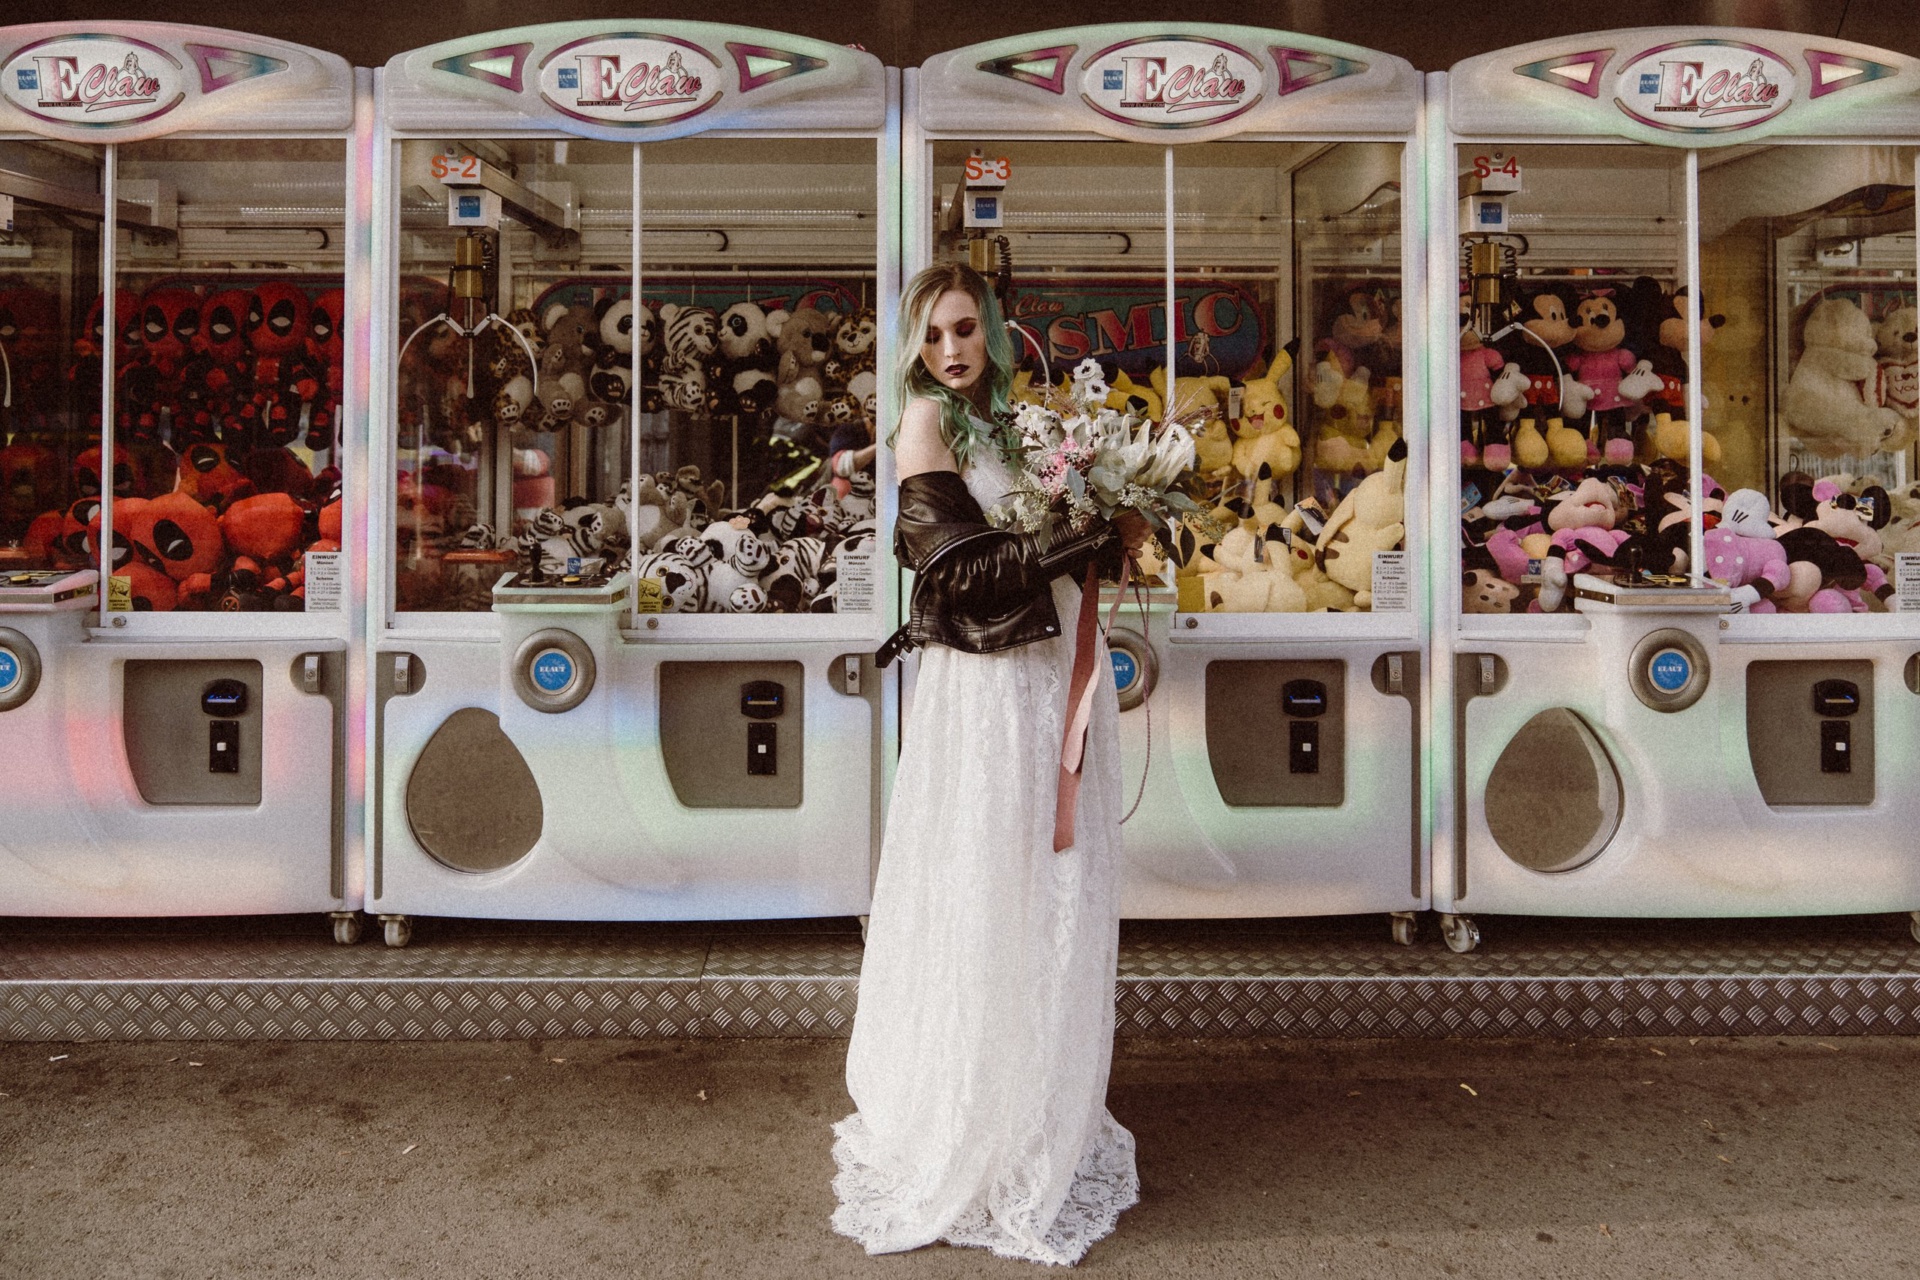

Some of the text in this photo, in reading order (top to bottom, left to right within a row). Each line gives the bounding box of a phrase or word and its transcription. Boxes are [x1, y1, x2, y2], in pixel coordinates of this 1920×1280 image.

[431, 155, 477, 179] S-2
[965, 156, 1012, 180] S-3
[1472, 156, 1519, 178] S-4
[1005, 290, 1243, 369] OSMIC
